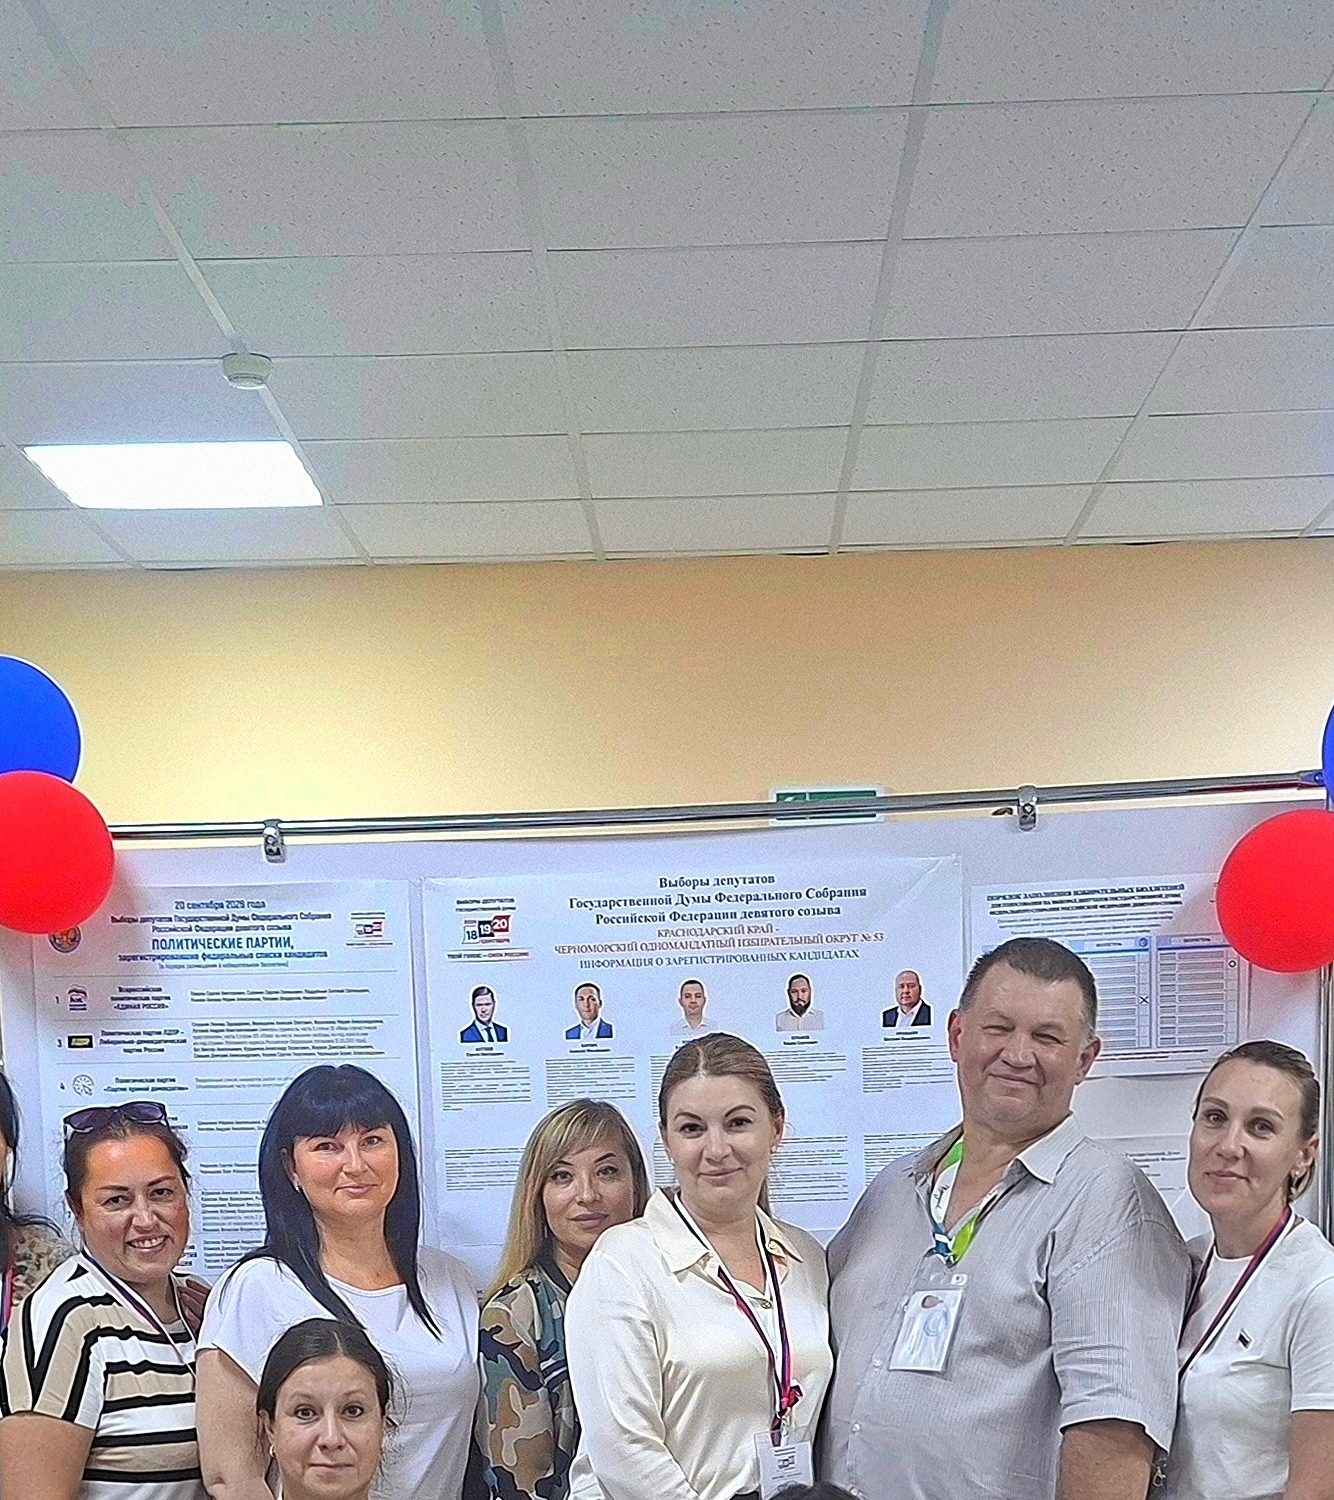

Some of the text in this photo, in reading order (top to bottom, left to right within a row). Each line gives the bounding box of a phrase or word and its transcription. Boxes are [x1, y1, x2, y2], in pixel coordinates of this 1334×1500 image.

[659, 875, 775, 890] Выборы депутатов
[569, 888, 867, 911] Государственной Думы Федерального Собрания
[596, 907, 841, 925] Российской Федерации девятого созыва
[479, 923, 491, 935] 19
[492, 919, 508, 930] 20
[657, 925, 745, 938] КРАСНОДАРСКИЙ
[747, 923, 774, 935] КРАЙ
[465, 930, 478, 940] 18
[152, 936, 294, 950] ПОЛИТИЧЕСКИЕ ПАРТИИ,
[554, 941, 638, 954] ЧЕРНОМОРСКИЙ
[640, 937, 736, 952] ОДНОМАНДАТНЫЙ
[738, 934, 824, 948] ИЗБИРАТЕЛЬНЫЙ
[825, 933, 859, 944] ОКРУГ
[579, 949, 860, 969] ИНФОРМАЦИЯ О ЗАРЕГИСТРИРОВАННЫХ КАНДИДАТАХ
